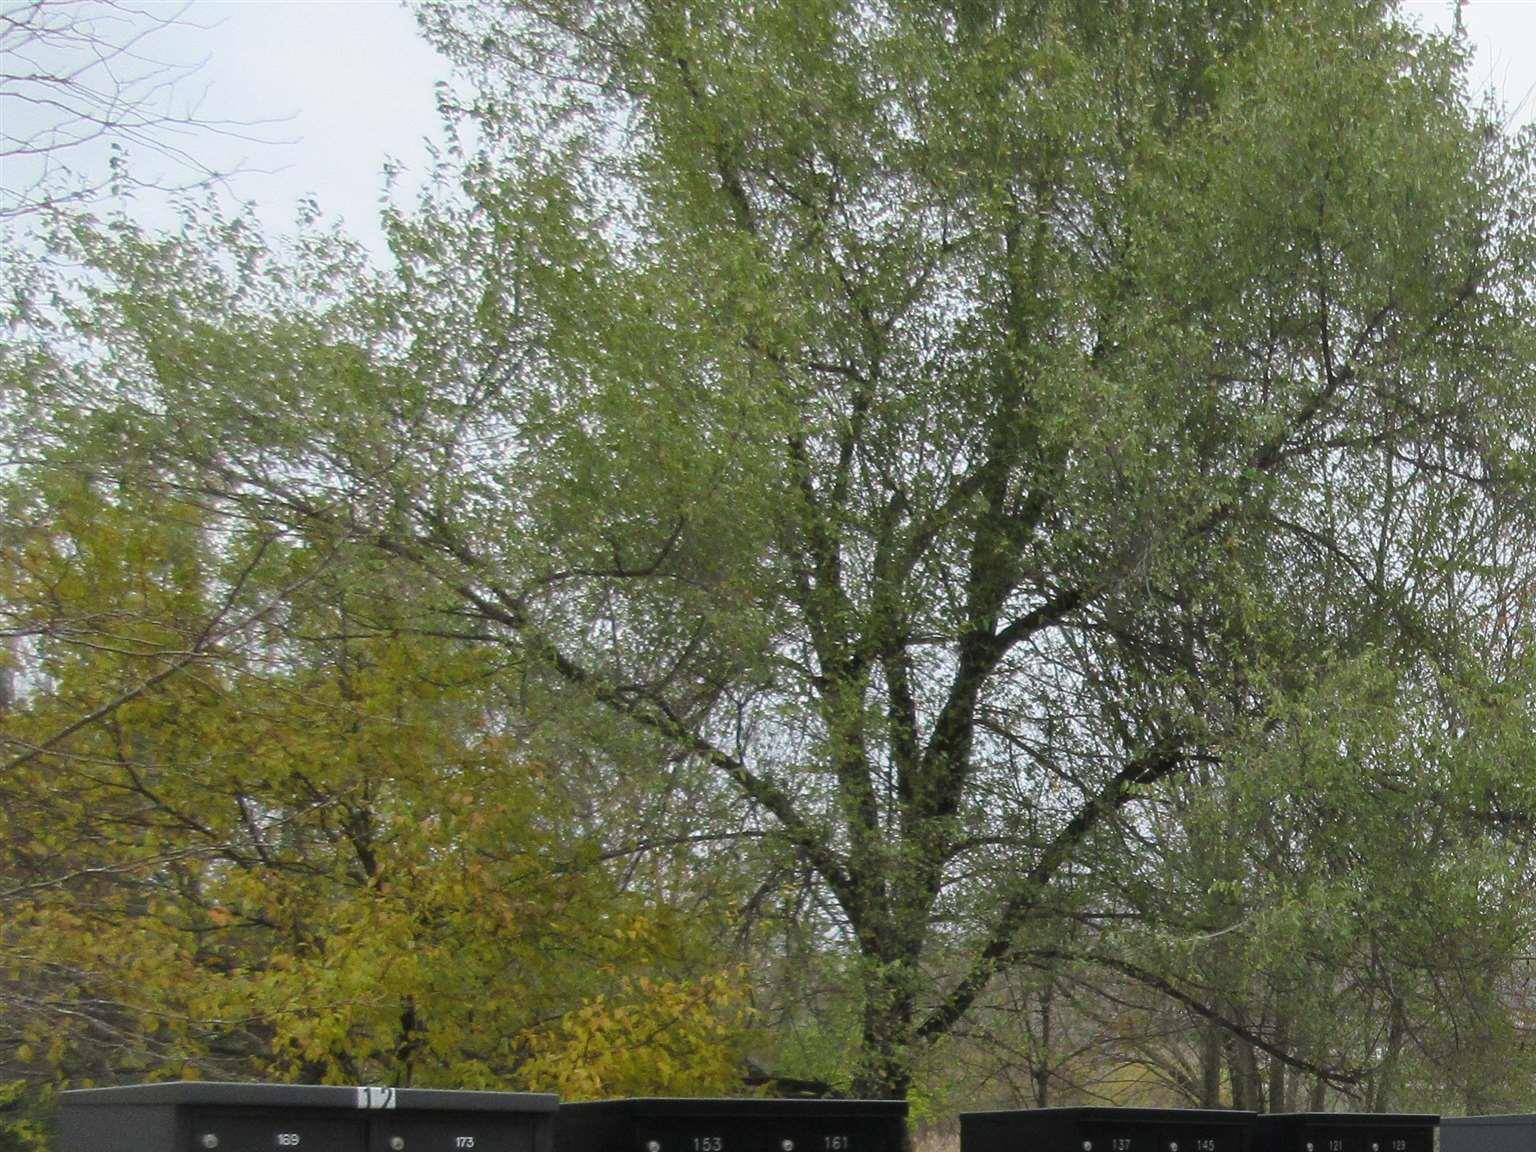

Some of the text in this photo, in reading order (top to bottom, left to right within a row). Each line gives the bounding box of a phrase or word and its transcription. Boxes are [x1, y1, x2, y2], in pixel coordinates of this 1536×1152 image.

[455, 1136, 475, 1149] 173
[693, 1136, 723, 1152] 153
[824, 1135, 848, 1150] 161
[1112, 1138, 1132, 1151] 137
